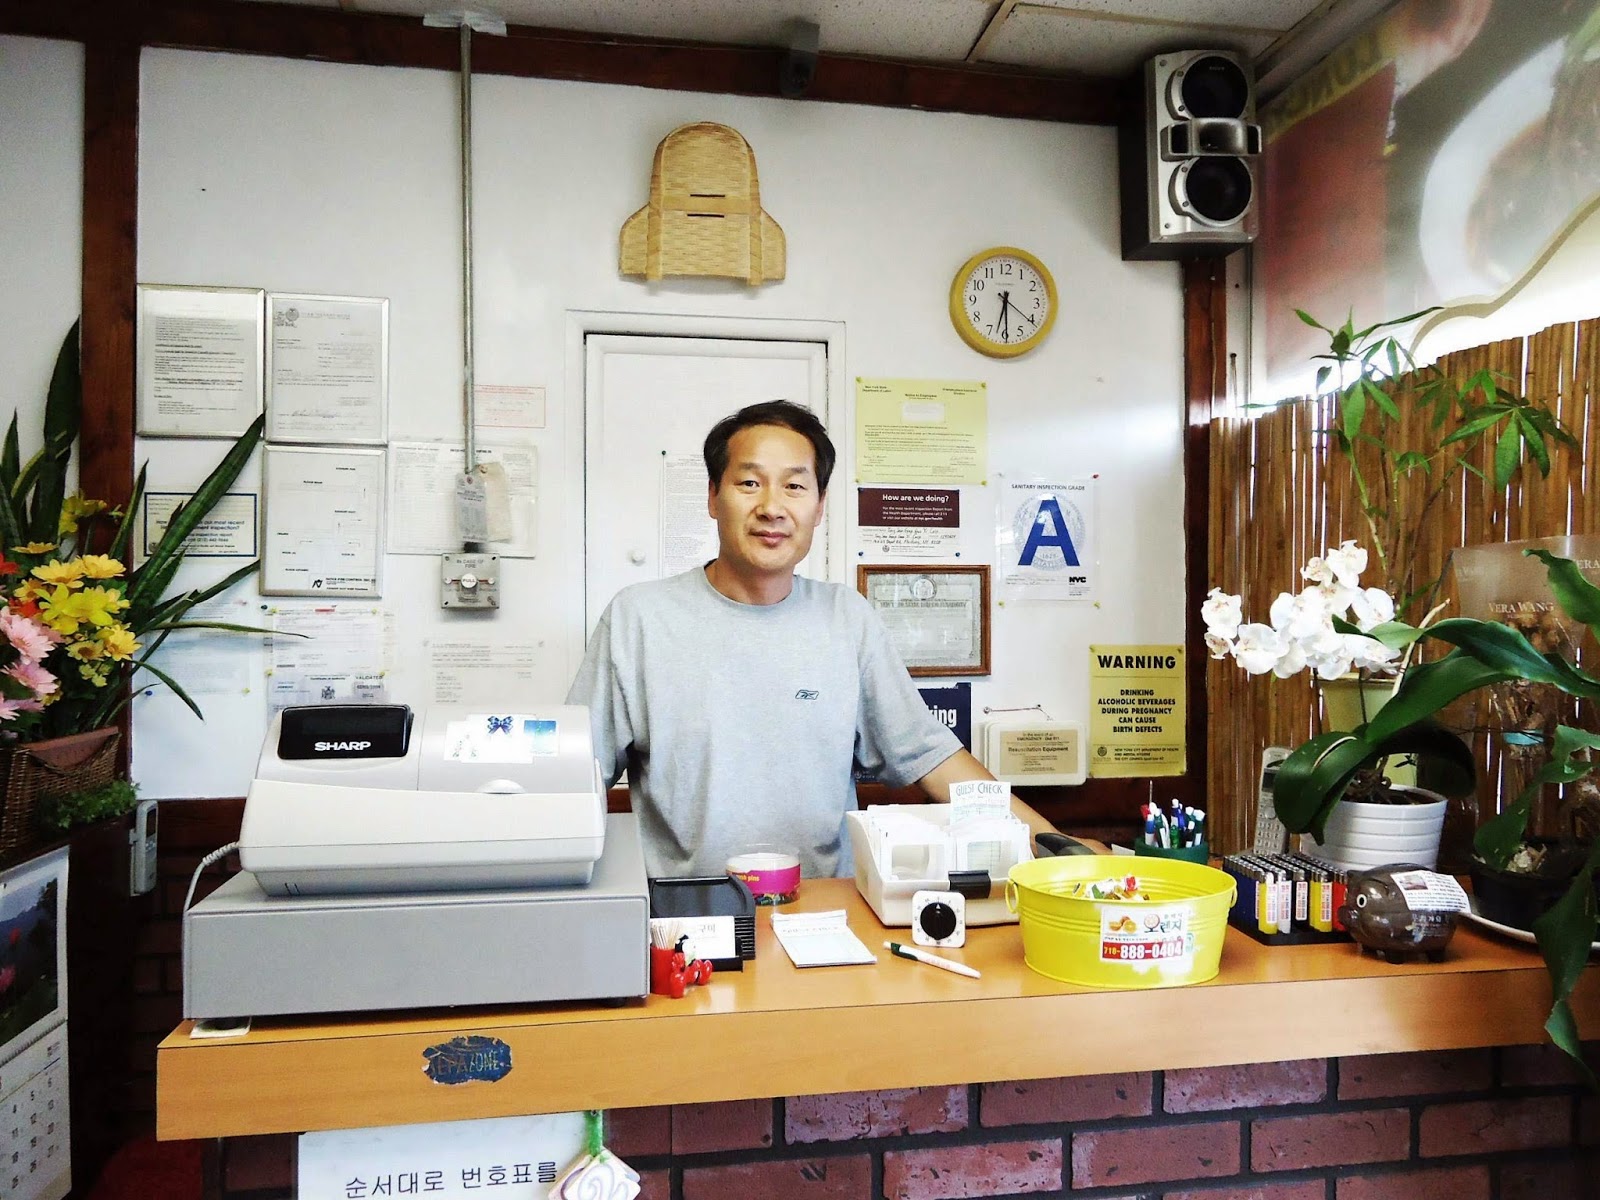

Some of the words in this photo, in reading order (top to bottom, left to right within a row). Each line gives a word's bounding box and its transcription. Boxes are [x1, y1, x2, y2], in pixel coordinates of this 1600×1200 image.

[985, 268, 993, 278] 11
[1000, 264, 1012, 275] 12
[974, 280, 984, 291] 10
[1029, 281, 1036, 291] 2
[969, 295, 976, 306] 9
[1033, 298, 1040, 309] 3
[974, 311, 980, 322] 8
[1028, 314, 1034, 324] 4
[986, 325, 993, 335] 7
[1002, 329, 1008, 340] 6
[1017, 326, 1023, 336] 5
[925, 495, 949, 503] doing?
[1018, 496, 1080, 566] A
[1577, 560, 1600, 569] ERA
[1489, 602, 1516, 613] VERA
[1518, 601, 1554, 612] WANG
[1098, 655, 1176, 669] WARNING
[314, 741, 371, 751] SHARP
[956, 784, 975, 796] GUEST
[977, 782, 1002, 794] CHECK
[1144, 914, 1182, 933] 오렌지
[345, 1170, 445, 1200] 순서대로
[462, 1161, 558, 1190] 번호표를
